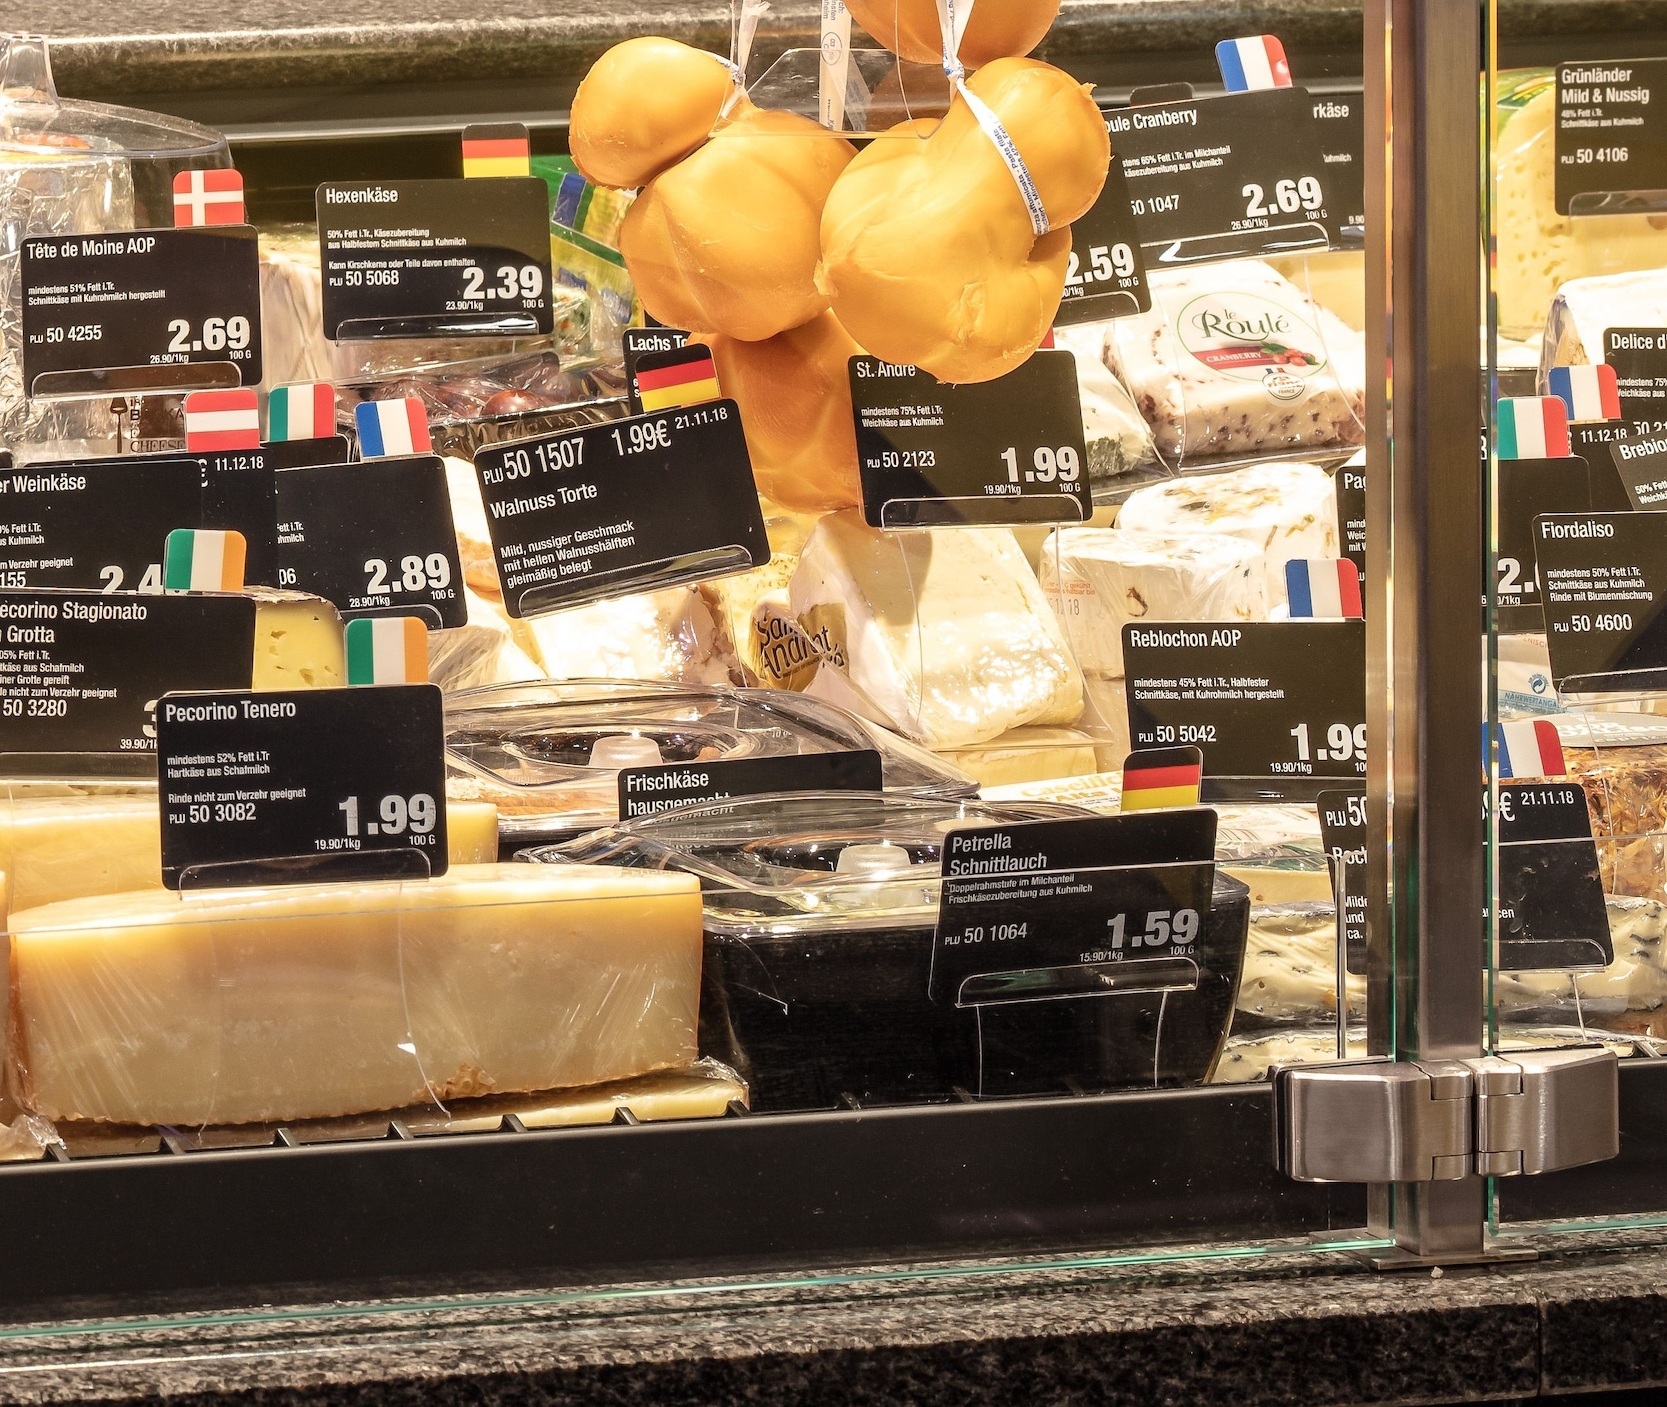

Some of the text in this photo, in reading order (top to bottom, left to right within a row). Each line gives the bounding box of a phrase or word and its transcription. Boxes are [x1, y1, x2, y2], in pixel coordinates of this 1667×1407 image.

[1561, 67, 1632, 84] Grünländer
[1561, 86, 1650, 104] Mild & Nussig
[1132, 109, 1197, 129] Cranberry
[1560, 147, 1628, 164] PLU 50 4106
[325, 186, 398, 204] Hexenkäse
[1242, 176, 1323, 218] 2.69
[26, 236, 155, 259] Tête de Moine AOP
[462, 265, 543, 299] 2.39
[167, 315, 250, 353] 2.69
[1191, 309, 1292, 342] Roulé
[628, 334, 671, 351] Lachs
[1611, 333, 1653, 349] Delice
[1206, 351, 1262, 364] CRANBERRY
[674, 407, 728, 429] 21.11.18
[611, 419, 671, 456] 1.99€
[214, 455, 264, 471] 11.12.18
[483, 437, 585, 485] PLU 50 1507
[1000, 446, 1079, 482] 1.99
[12, 474, 86, 493] Weinkäse
[489, 483, 597, 519] Walnuss Torte
[527, 534, 572, 552] nussiger
[573, 520, 635, 542] Geschmack
[1541, 520, 1614, 538] Fiordaliso
[503, 536, 635, 573] mit hellen Walnusshälften
[364, 552, 450, 595] 2.89
[558, 558, 592, 575] belegt
[1549, 590, 1653, 602] Rinde mit Blumenmischung
[62, 601, 147, 623] Stagionato
[6, 624, 55, 643] Grotta
[1130, 629, 1241, 647] Reblochon AOP
[16, 674, 42, 684] Grotte
[43, 674, 70, 686] gereift
[165, 699, 296, 722] Pecorino Tenero
[627, 770, 709, 792] Frischkäse
[1520, 790, 1574, 805] 21.11.18
[338, 793, 436, 836] 1.99
[952, 833, 1011, 853] Petrella
[949, 852, 1047, 876] Schnittlauch
[1106, 908, 1199, 949] 1.59
